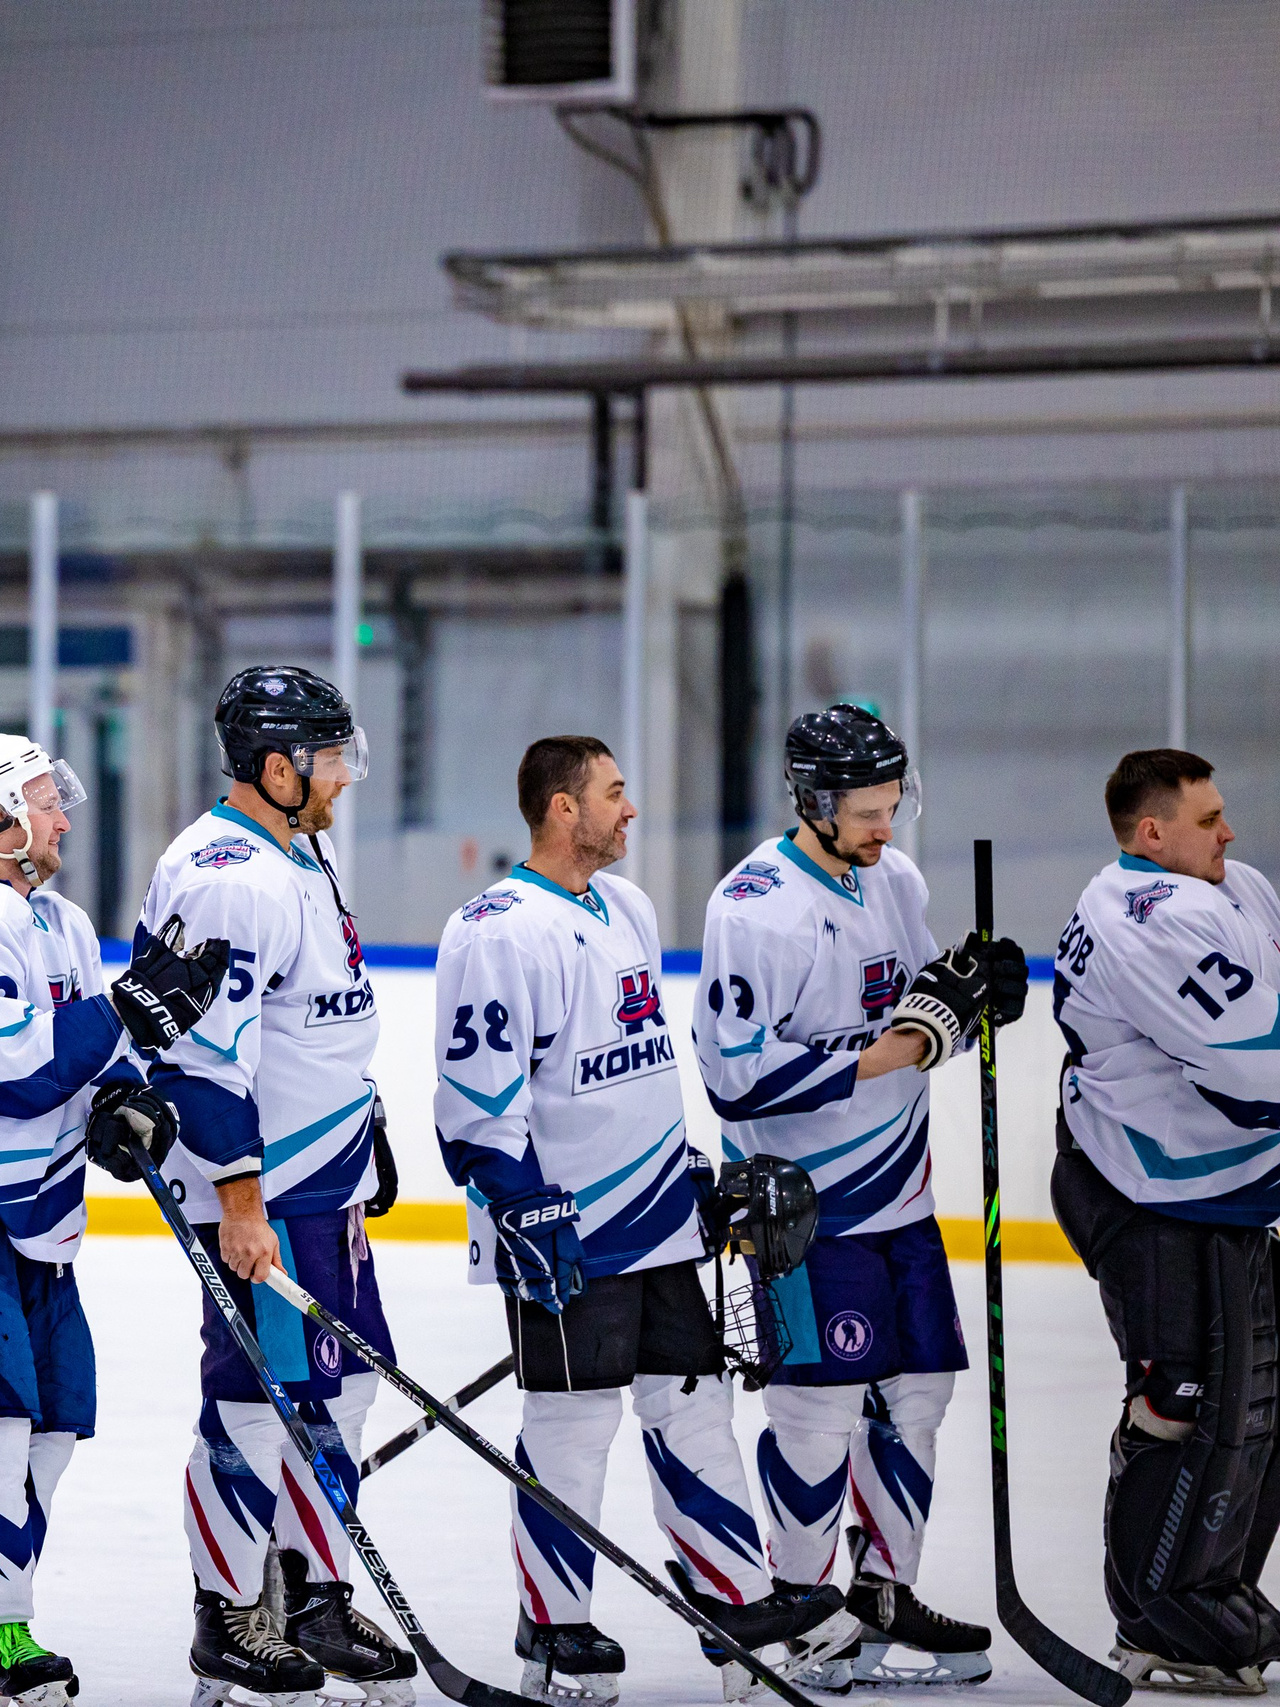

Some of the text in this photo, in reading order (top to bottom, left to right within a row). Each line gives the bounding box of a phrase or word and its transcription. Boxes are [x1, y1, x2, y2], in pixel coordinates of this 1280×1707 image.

[261, 722, 299, 731] BAUER
[792, 761, 817, 771] BAUER
[875, 754, 903, 769] BAUER
[1177, 951, 1255, 1021] 13
[445, 998, 514, 1061] 38
[768, 1176, 778, 1217] BAUER
[190, 1251, 236, 1310] BAUER
[332, 1319, 383, 1358] CCM
[356, 1348, 426, 1409] RIBCOR
[475, 1434, 531, 1480] RIBCOR
[1145, 1466, 1194, 1592] WARRIOR
[345, 1522, 423, 1636] NEXUS
